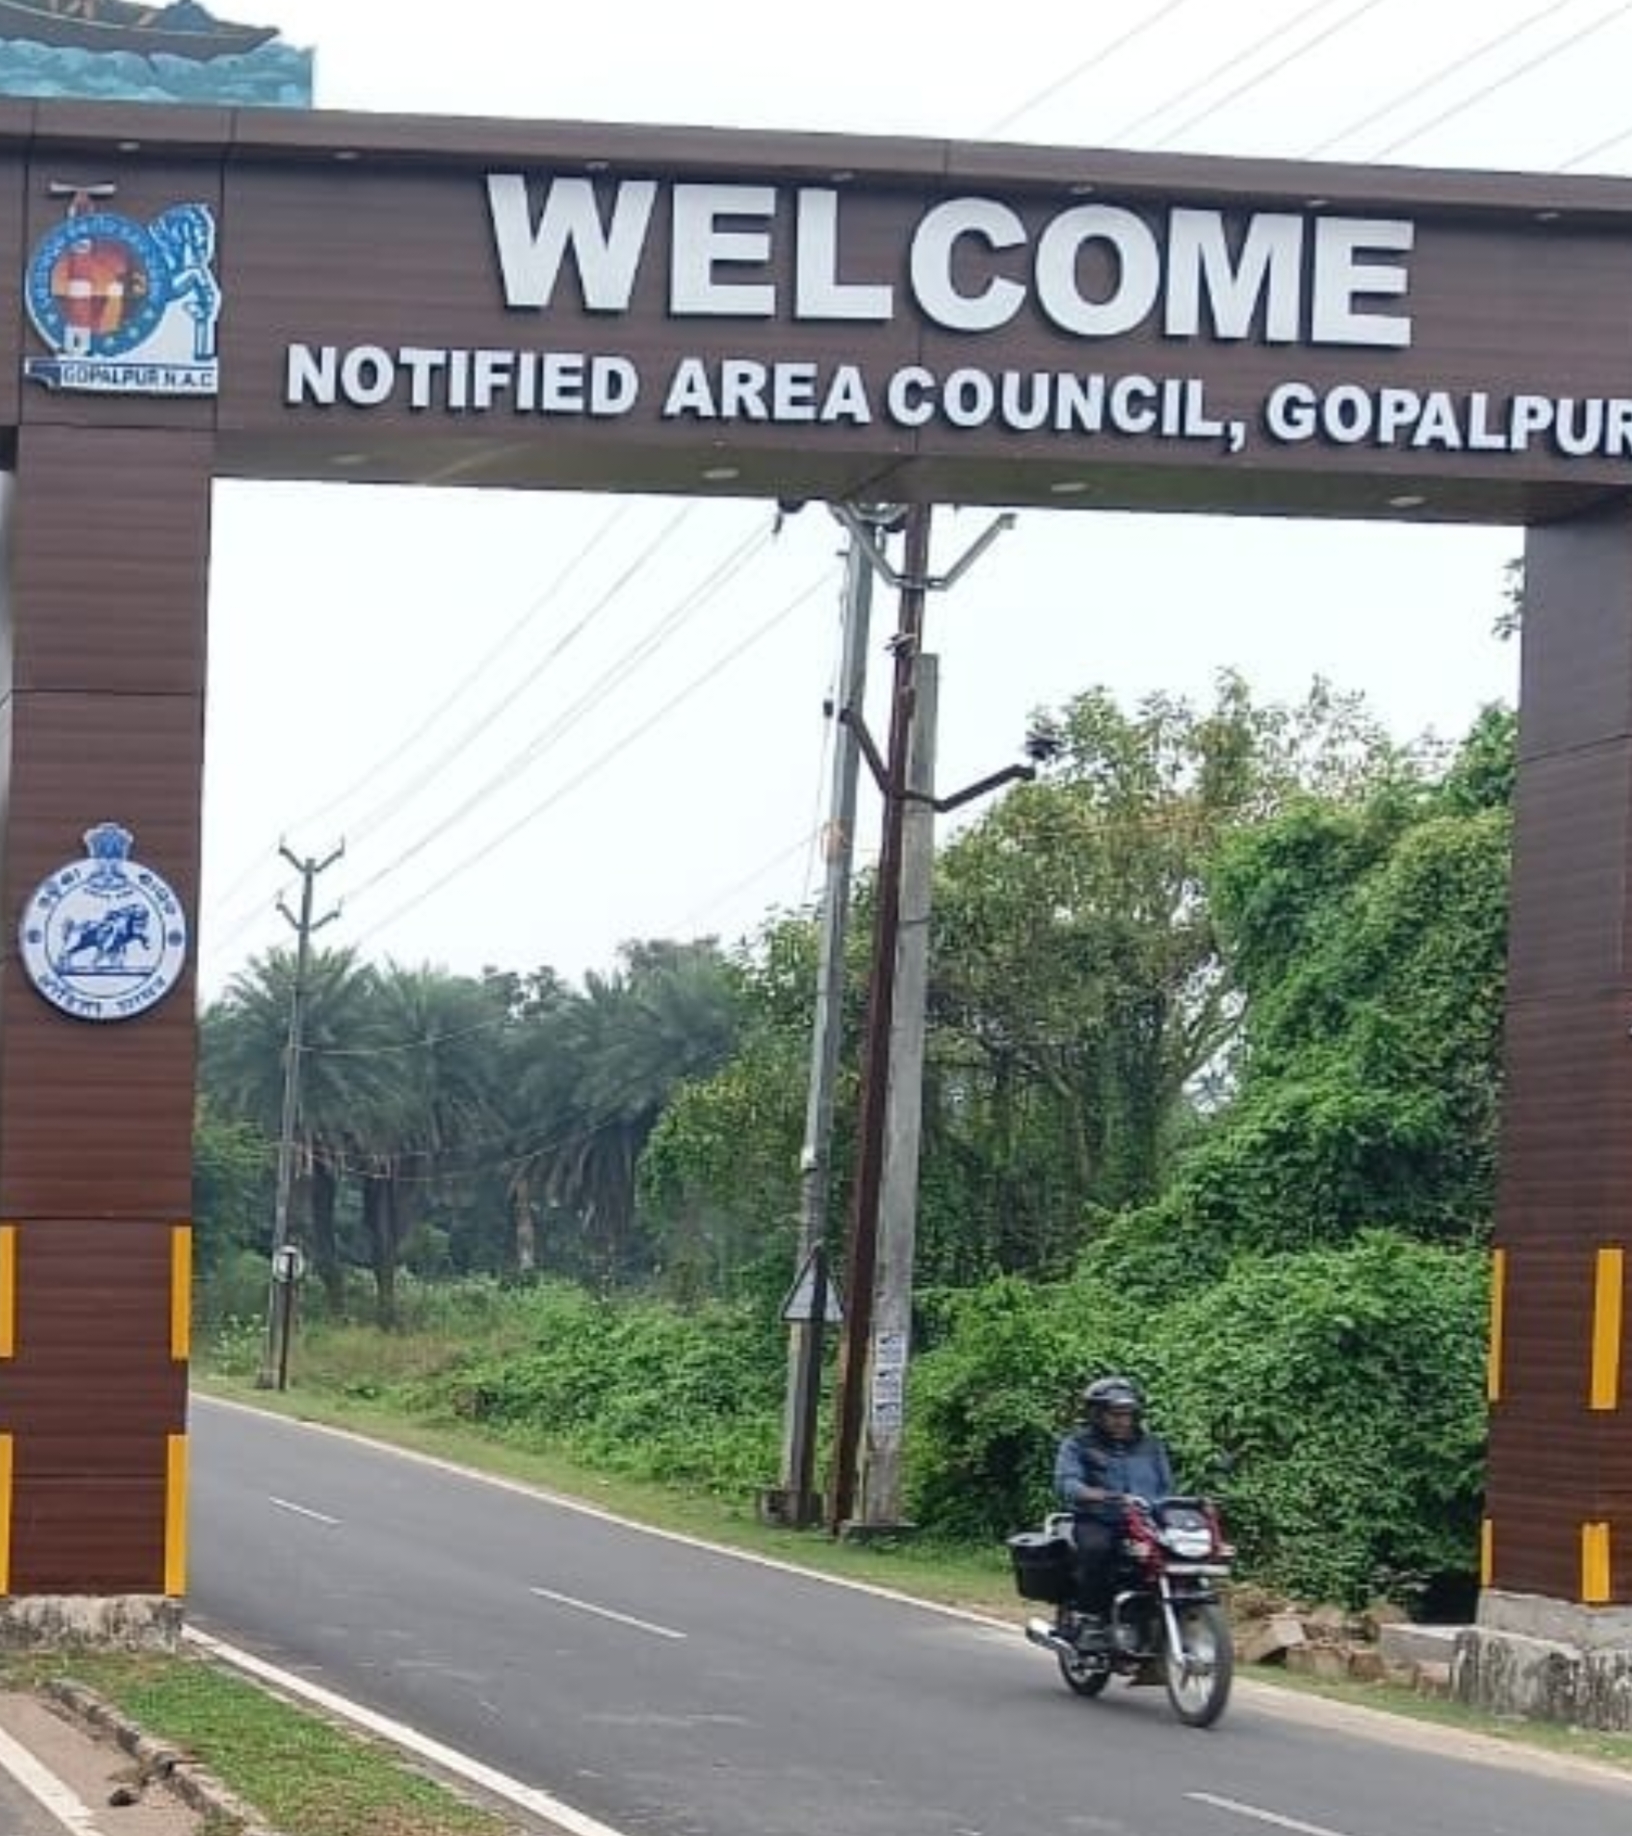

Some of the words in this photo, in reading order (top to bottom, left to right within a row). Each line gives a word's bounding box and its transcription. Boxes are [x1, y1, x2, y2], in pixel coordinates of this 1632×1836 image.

[489, 174, 1414, 346] WELCOME
[287, 343, 639, 414] NOTIFIED
[664, 358, 872, 423] AREA
[888, 366, 1246, 452] COUNCIL,
[1267, 382, 1632, 455] GOPALPUR
